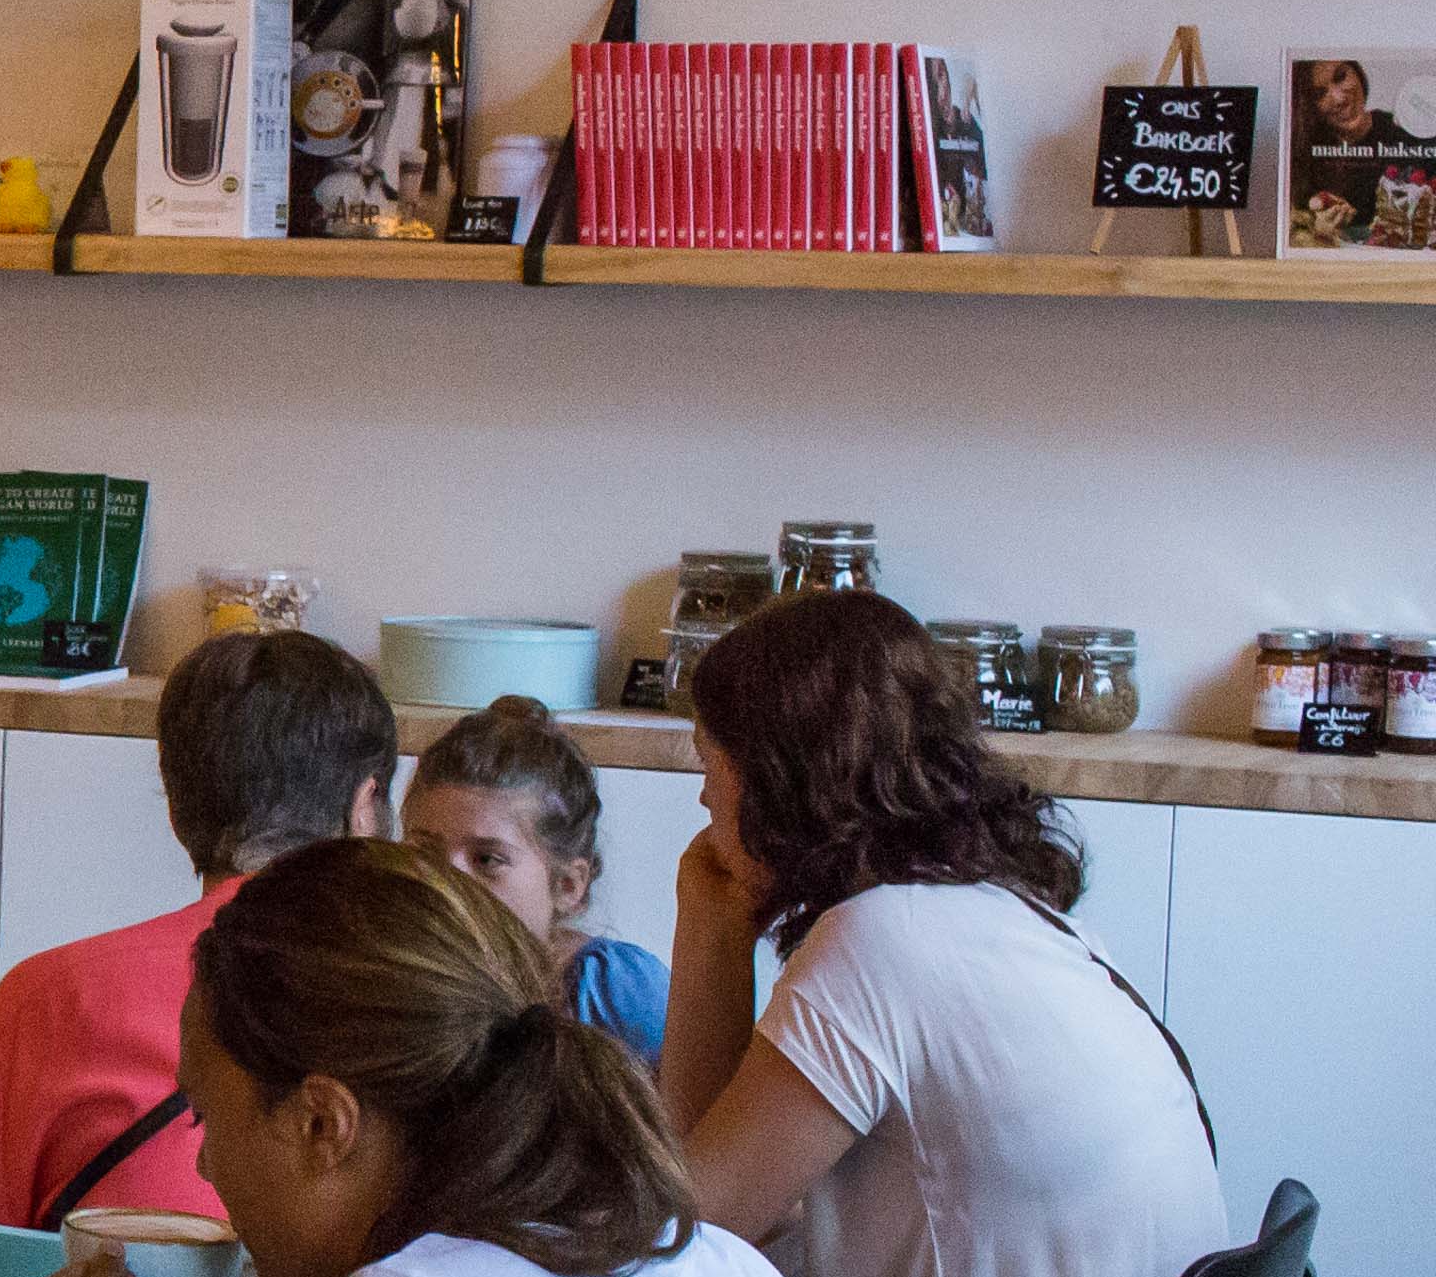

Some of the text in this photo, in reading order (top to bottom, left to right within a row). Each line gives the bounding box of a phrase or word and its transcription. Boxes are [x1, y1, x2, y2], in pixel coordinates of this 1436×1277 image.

[1161, 101, 1201, 120] ONS
[1133, 121, 1234, 155] BAKBOEK
[1311, 140, 1436, 158] madam bakste
[1125, 162, 1221, 201] €24.50
[4, 488, 23, 498] TO
[25, 488, 75, 499] CREATE
[28, 500, 75, 510] WORLD
